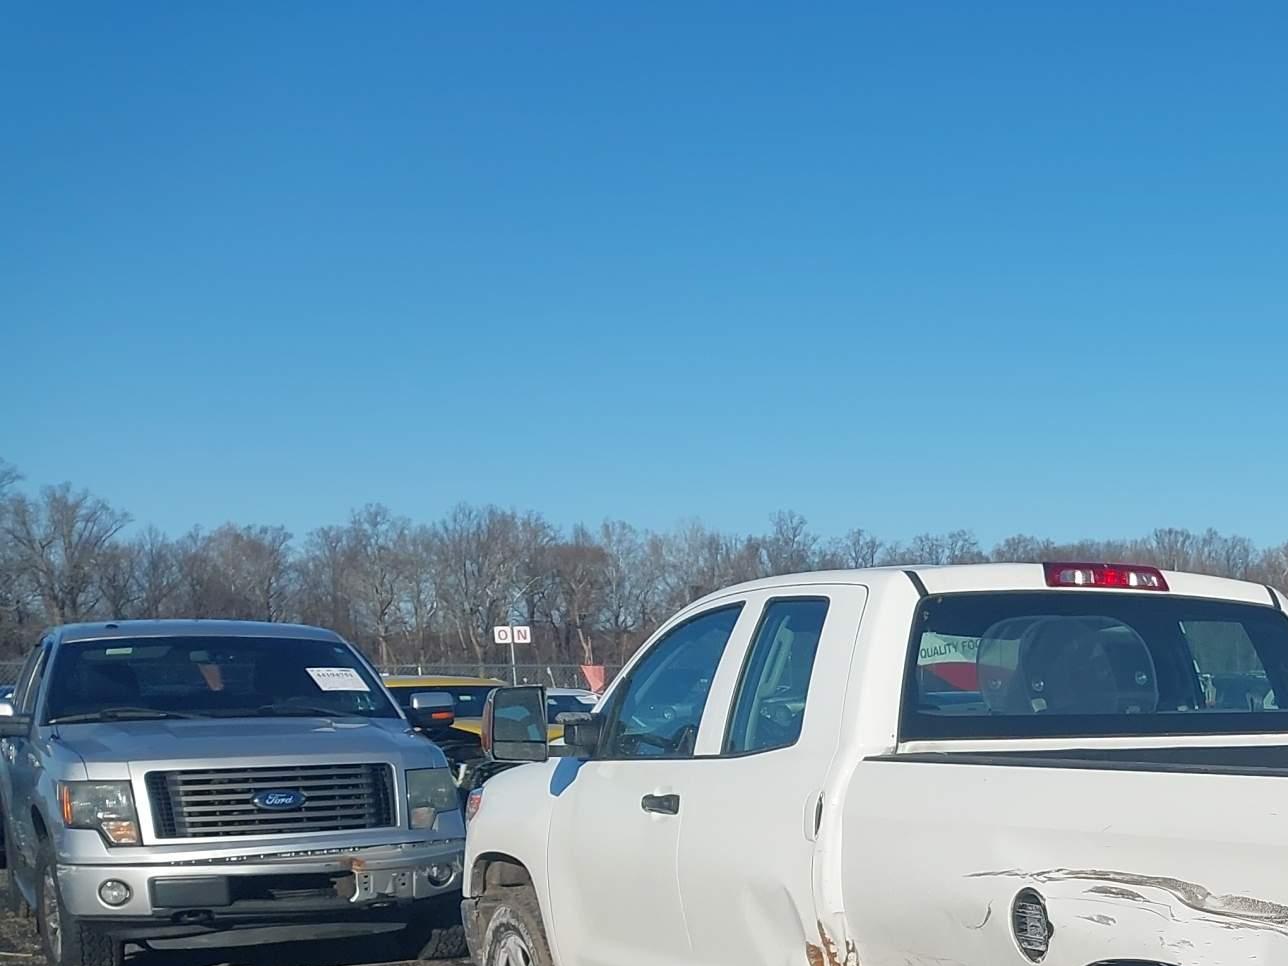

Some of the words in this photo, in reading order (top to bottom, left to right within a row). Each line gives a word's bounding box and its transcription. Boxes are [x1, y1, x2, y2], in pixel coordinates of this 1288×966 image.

[516, 629, 528, 641] N
[920, 641, 959, 659] QUALITY
[265, 793, 294, 805] Ford
